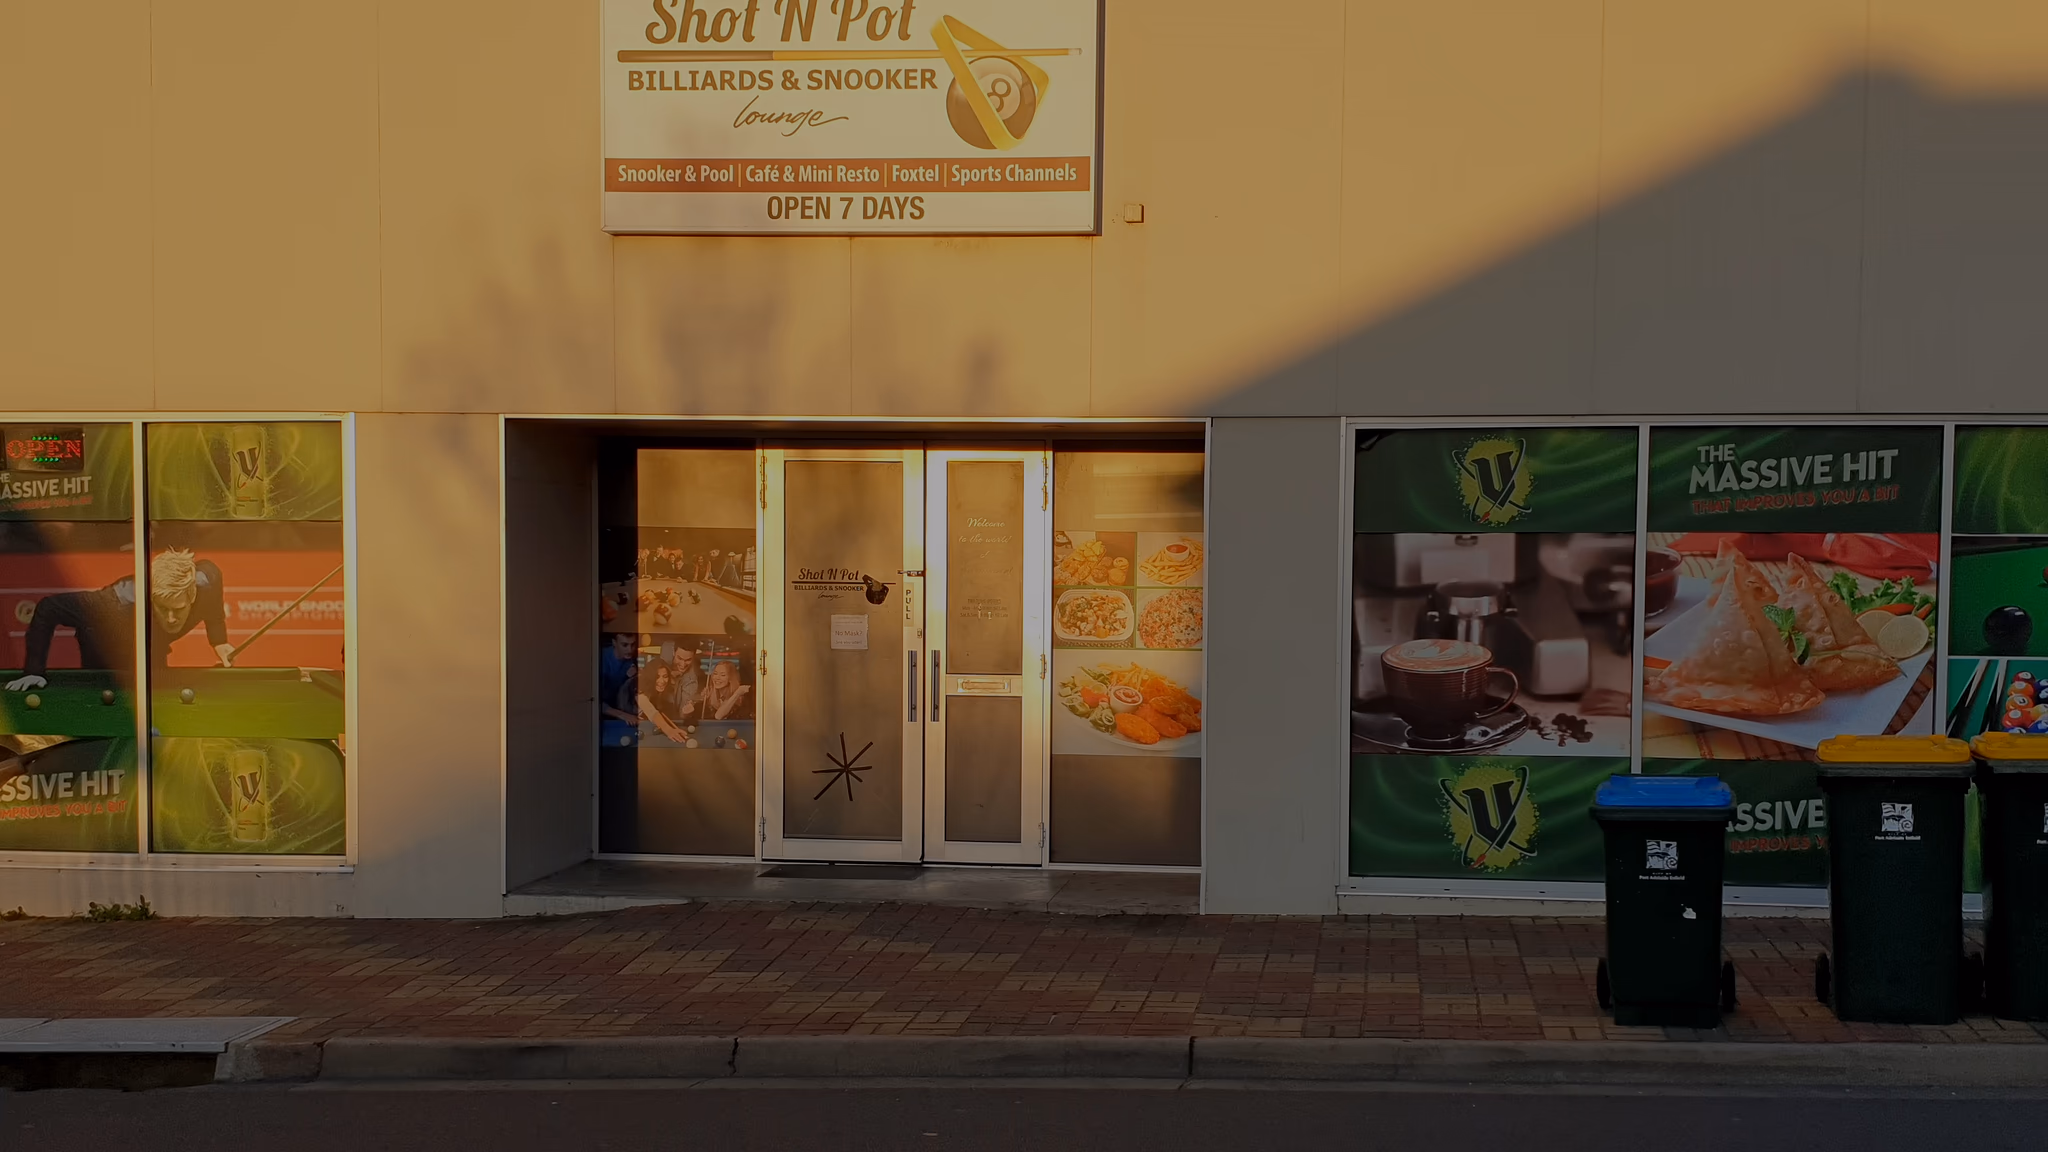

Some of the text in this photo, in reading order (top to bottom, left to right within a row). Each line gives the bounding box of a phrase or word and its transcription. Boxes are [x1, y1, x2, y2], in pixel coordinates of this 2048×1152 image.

[645, 0, 917, 44] Shot N Pot
[628, 69, 938, 91] BILLIARDS & SNOOKER
[733, 95, 849, 137] lounge
[618, 163, 1077, 186] Snooker & Pool Café & Mini Resto Foxtel Sports Channels
[767, 196, 925, 220] OPEN 7 DAYS
[6, 440, 82, 459] OPEN
[1697, 443, 1735, 463] THE
[1688, 449, 1899, 494] MASSIVE HIT
[0, 476, 92, 500] ASSIVE HIT
[1692, 485, 1900, 514] THAT IMPROVES YOU A BIT
[798, 568, 859, 581] Shot N Pot
[905, 589, 913, 620] PULL
[0, 769, 125, 802] SSIVE HIT
[65, 802, 92, 816] YOU
[1730, 836, 1812, 853] IMPROVES
